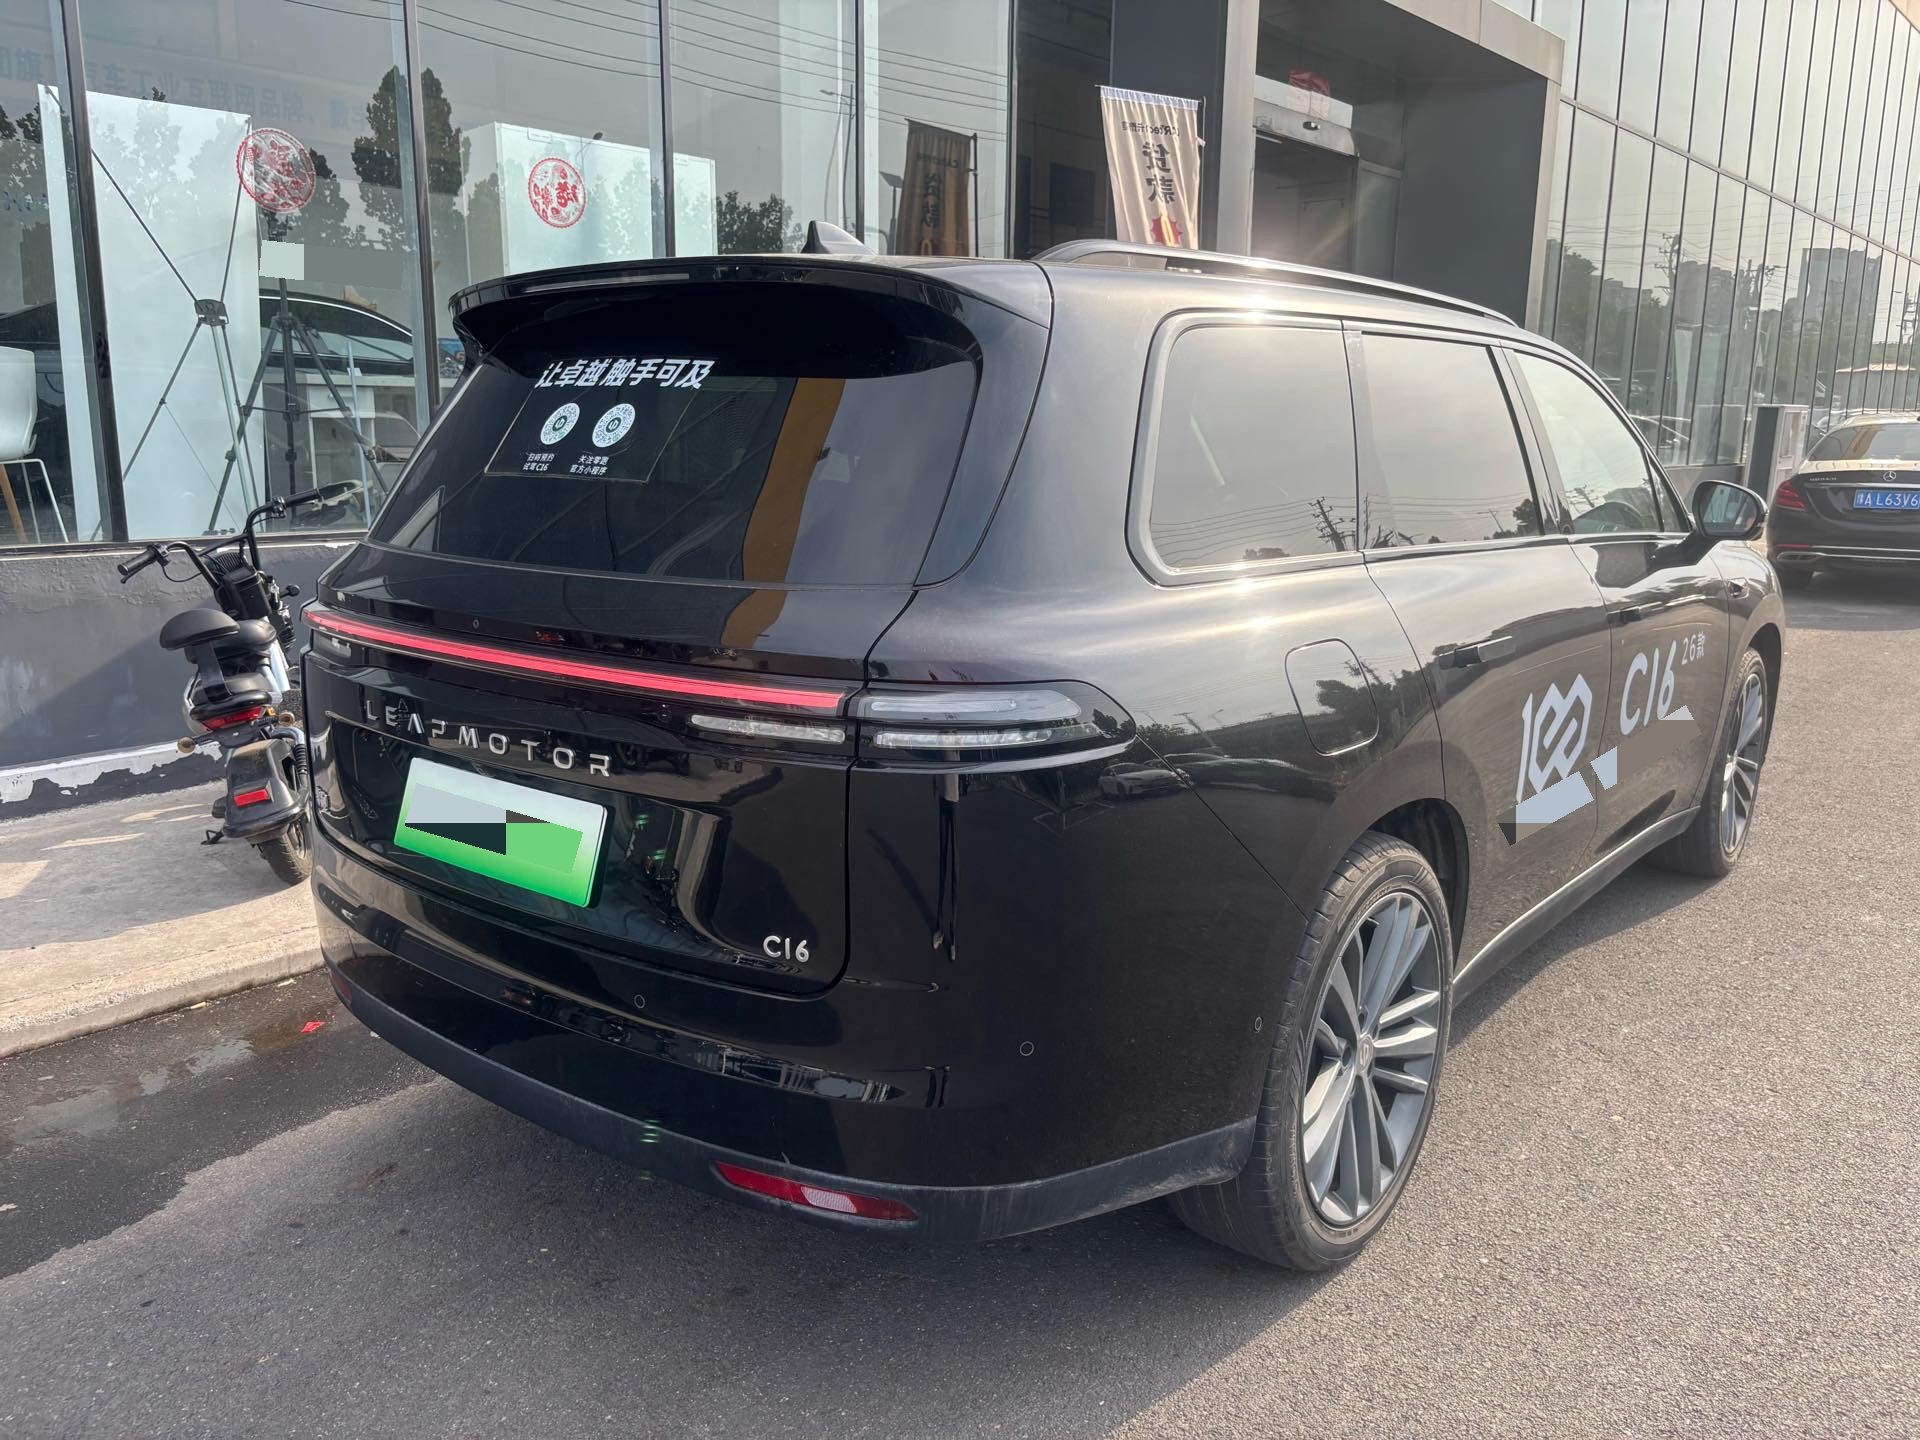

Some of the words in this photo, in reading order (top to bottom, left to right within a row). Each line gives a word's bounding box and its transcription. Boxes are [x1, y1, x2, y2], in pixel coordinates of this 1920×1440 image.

[534, 358, 716, 389] 让卓越触手可及
[570, 464, 608, 475] 官方小程序
[578, 454, 609, 465] 关注零跑
[1620, 640, 1677, 735] C16
[1681, 631, 1706, 665] 26款
[366, 700, 611, 777] LEAPMOTOR
[763, 935, 809, 962] C16
